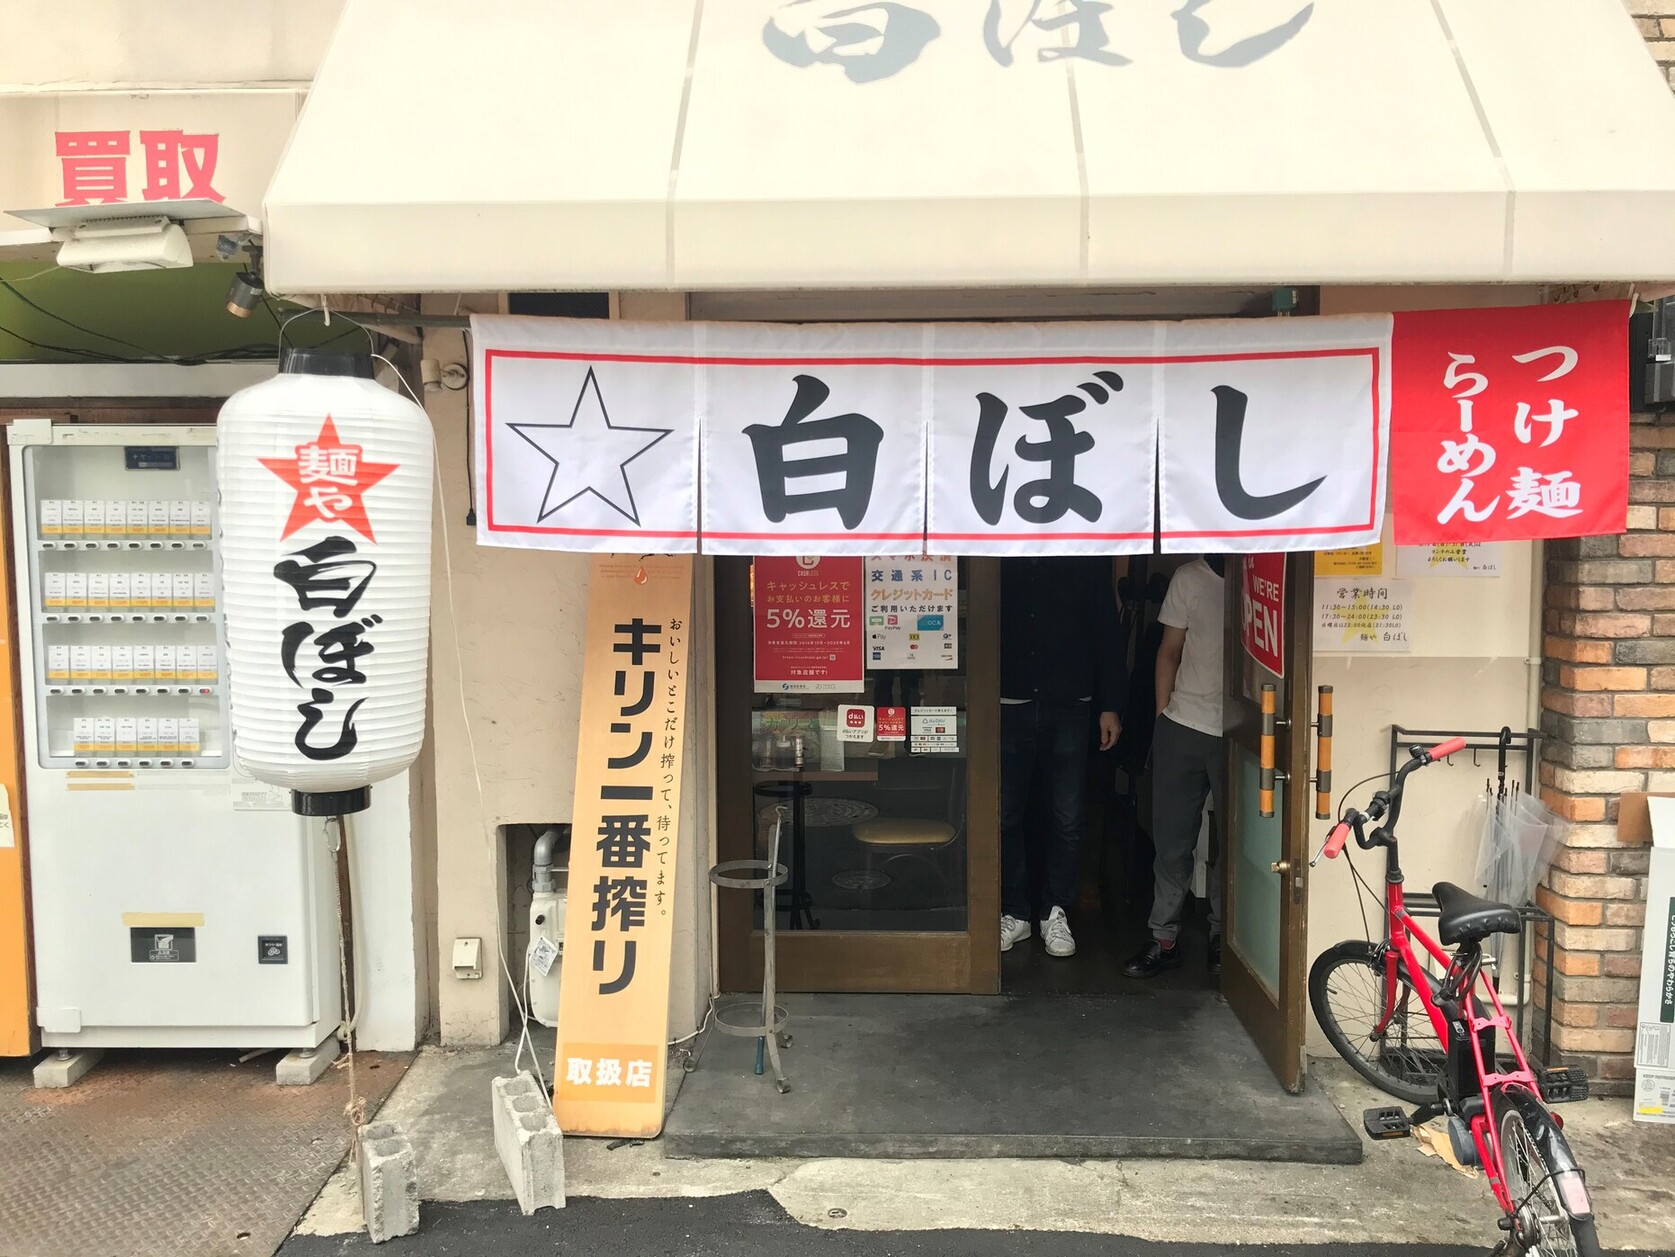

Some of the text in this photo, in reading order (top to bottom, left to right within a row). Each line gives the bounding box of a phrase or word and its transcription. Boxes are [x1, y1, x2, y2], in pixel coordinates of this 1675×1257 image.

[55, 130, 227, 207] 買取
[744, 371, 1327, 532] 白ぼし
[1436, 351, 1501, 526] らーめん
[1504, 344, 1584, 520] つけ麺
[297, 445, 361, 520] 麺や
[766, 580, 851, 592] キャッシュレスで
[766, 594, 850, 604] お支払いのお客様に
[766, 608, 851, 629] 5%還元
[871, 588, 954, 602] クレジットカード
[871, 604, 953, 613] ご利用いただけます
[1336, 586, 1389, 600] 営業時間
[272, 536, 384, 761] 白ぼし
[1241, 592, 1279, 658] OPEN
[878, 724, 905, 732] 5%還元
[653, 617, 683, 918] おいしいとこだけ搾って、待ってます。
[590, 617, 662, 996] キリン一番搾り
[565, 1056, 653, 1089] 取扱店
